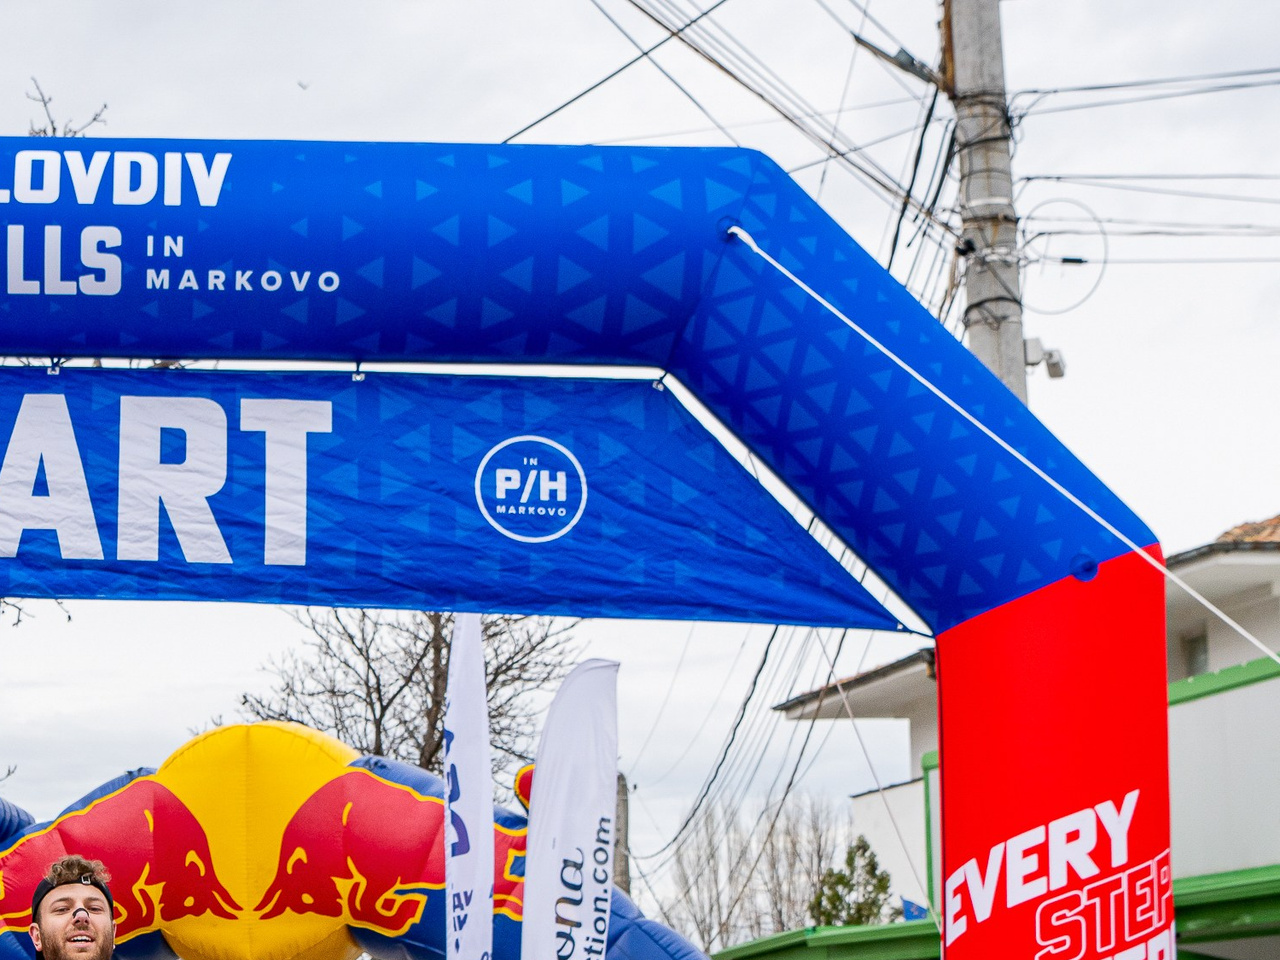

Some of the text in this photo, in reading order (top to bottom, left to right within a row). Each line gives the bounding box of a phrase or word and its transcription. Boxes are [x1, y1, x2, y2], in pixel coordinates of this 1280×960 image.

[146, 235, 184, 258] IN
[145, 268, 340, 292] MARKOVO
[523, 457, 538, 466] IN
[496, 468, 567, 503] P/H
[496, 505, 567, 517] MARKOVO
[945, 789, 1140, 948] EVERY
